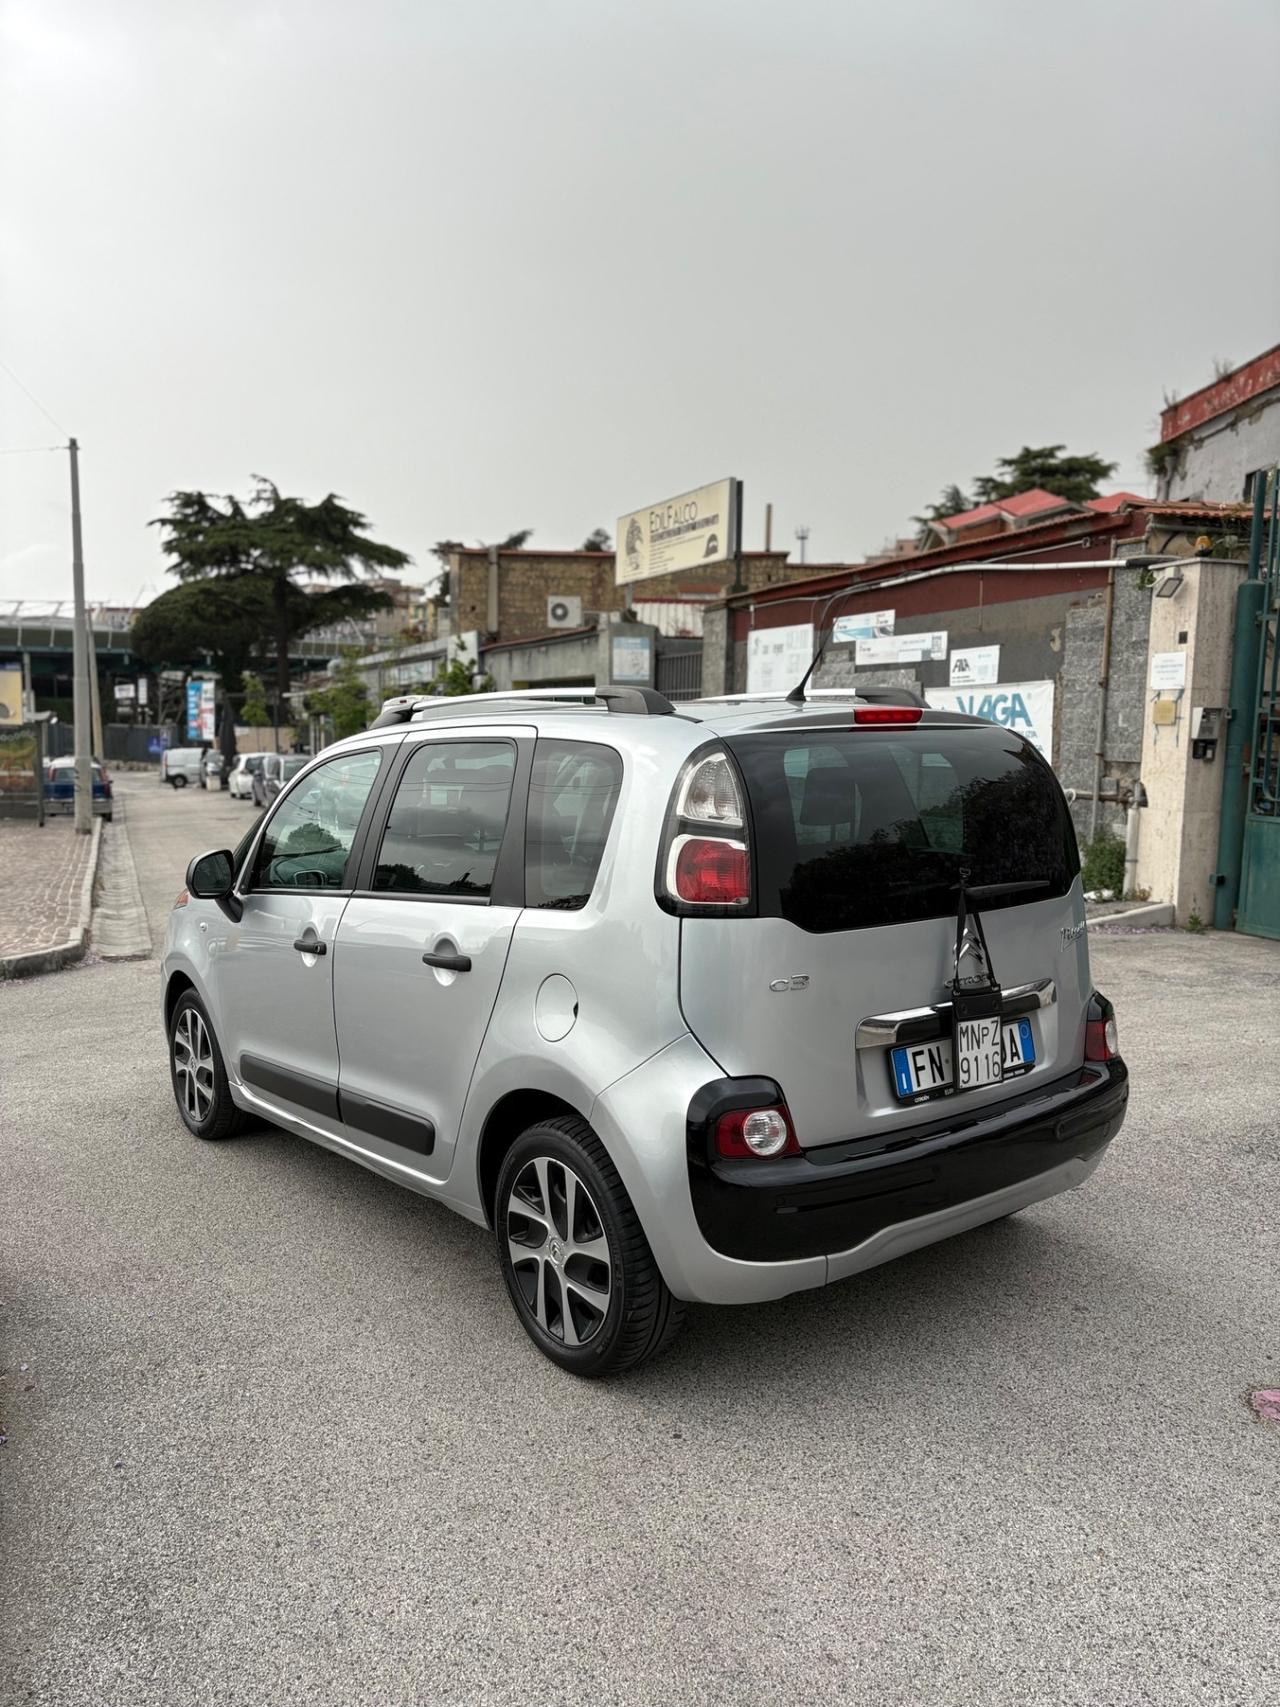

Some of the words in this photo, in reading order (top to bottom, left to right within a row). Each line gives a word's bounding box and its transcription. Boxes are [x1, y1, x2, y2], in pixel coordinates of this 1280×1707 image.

[769, 973, 810, 992] C3
[911, 1046, 945, 1087] FN
[961, 1051, 1001, 1085] 9116
